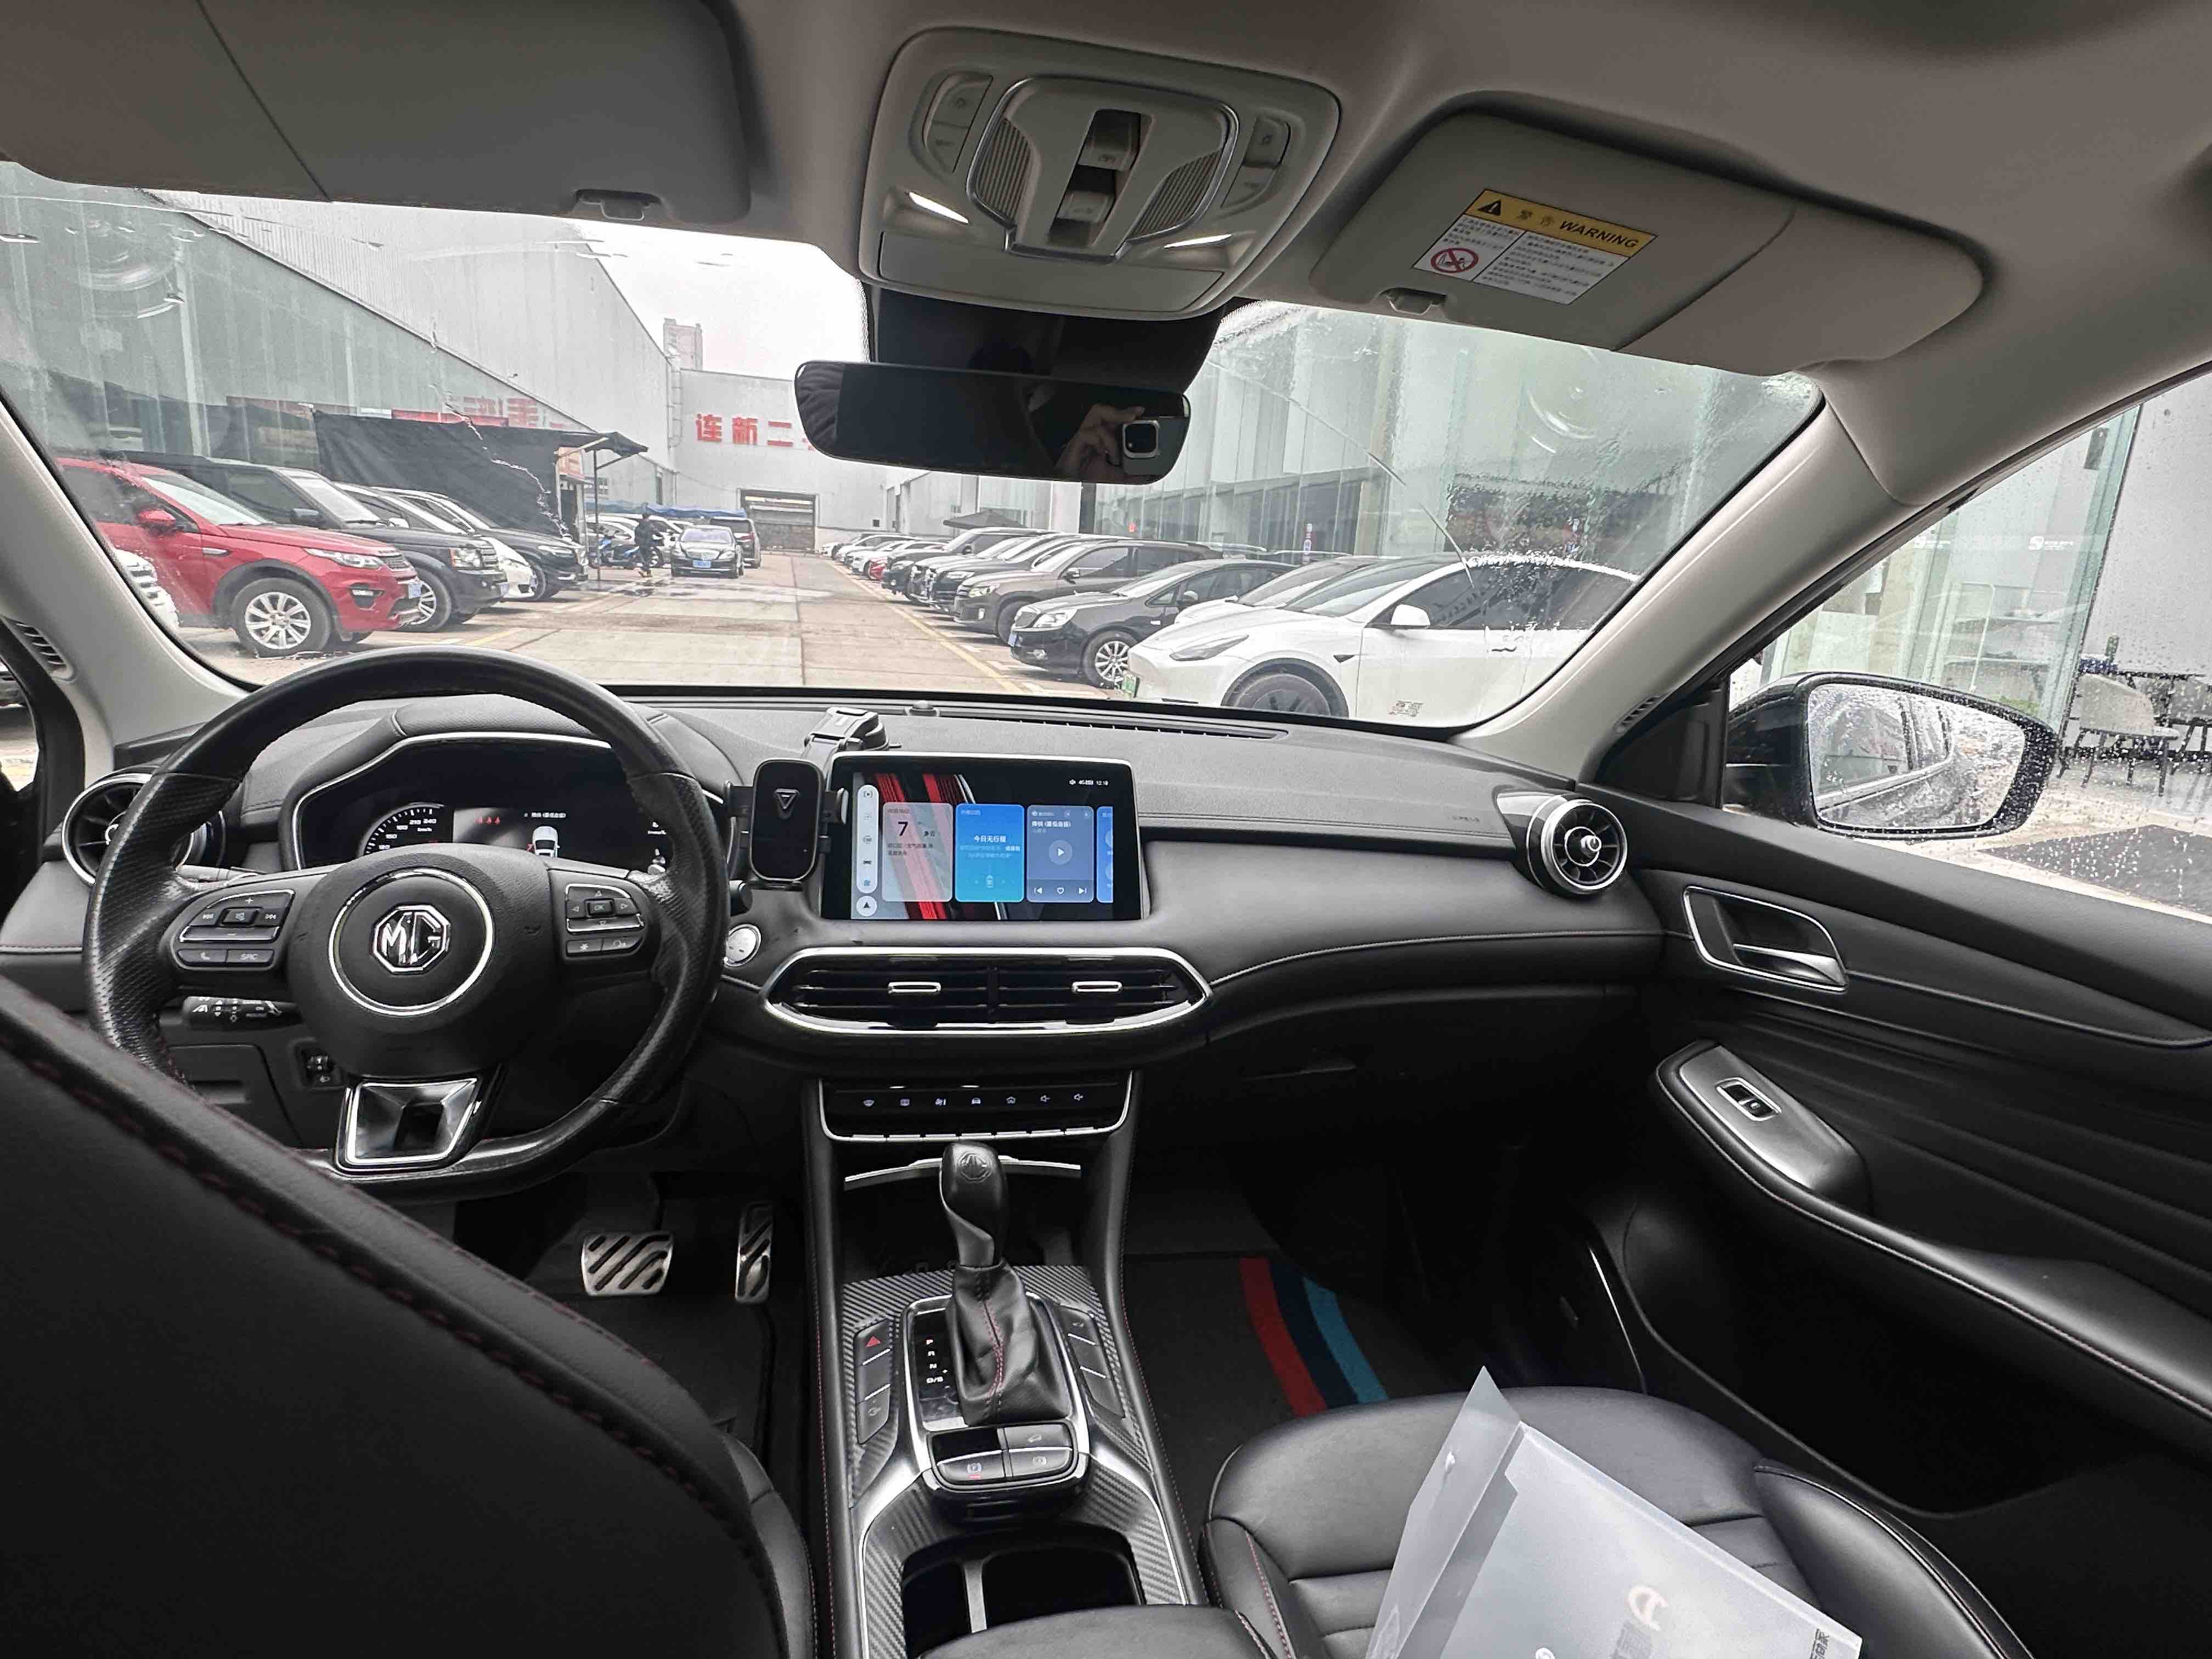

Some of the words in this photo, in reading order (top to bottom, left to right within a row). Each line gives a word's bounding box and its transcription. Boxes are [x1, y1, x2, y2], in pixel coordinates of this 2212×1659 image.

[1559, 219, 1639, 248] WARNING
[696, 414, 815, 451] 连新二
[898, 821, 909, 837] 7
[380, 910, 443, 967] MG
